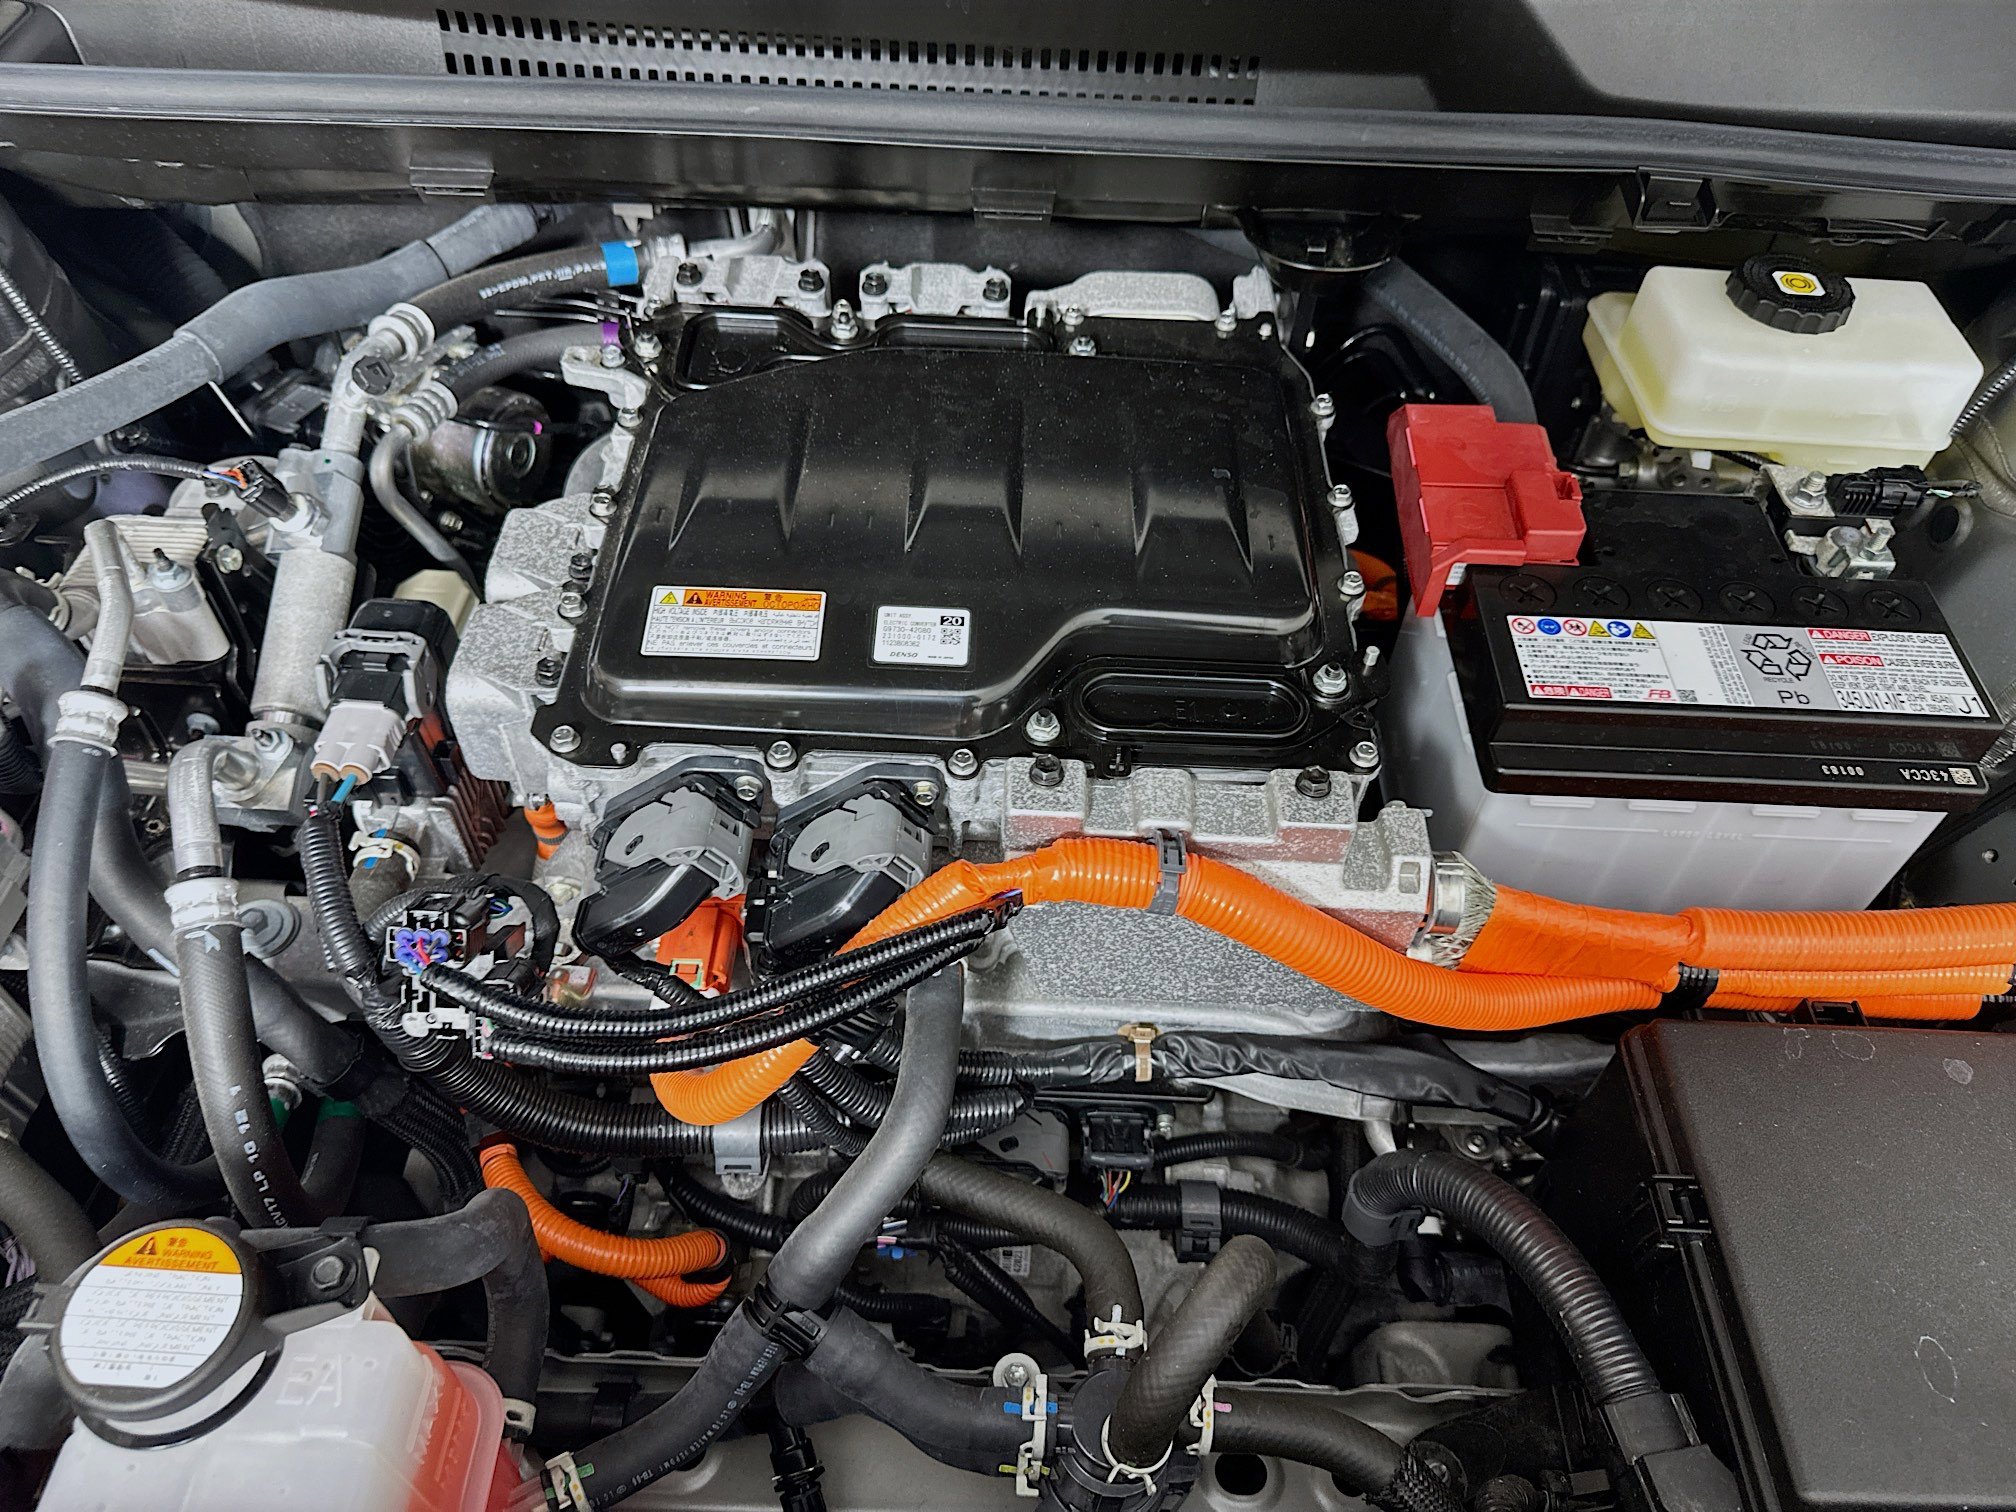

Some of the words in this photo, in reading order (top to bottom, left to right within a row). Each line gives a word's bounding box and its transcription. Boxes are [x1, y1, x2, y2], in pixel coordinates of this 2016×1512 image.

[704, 598, 757, 607] AVERTISSEMENT
[706, 591, 747, 600] WARNING
[942, 616, 963, 626] 20
[1824, 631, 1870, 641] DANGER
[1872, 632, 1916, 643] EXPLOSIVE
[1917, 634, 1948, 645] GASES
[1836, 655, 1883, 666] POISON
[1579, 687, 1611, 698] DANGER
[1777, 690, 1810, 705] Pb
[1837, 690, 1906, 711] 345LN1-MF
[1959, 696, 1986, 715] J1
[1900, 768, 1950, 782] 43CCA
[252, 1170, 270, 1193] LP
[162, 1248, 213, 1260] WARNING
[123, 1256, 219, 1271] AVERTISSEMENT
